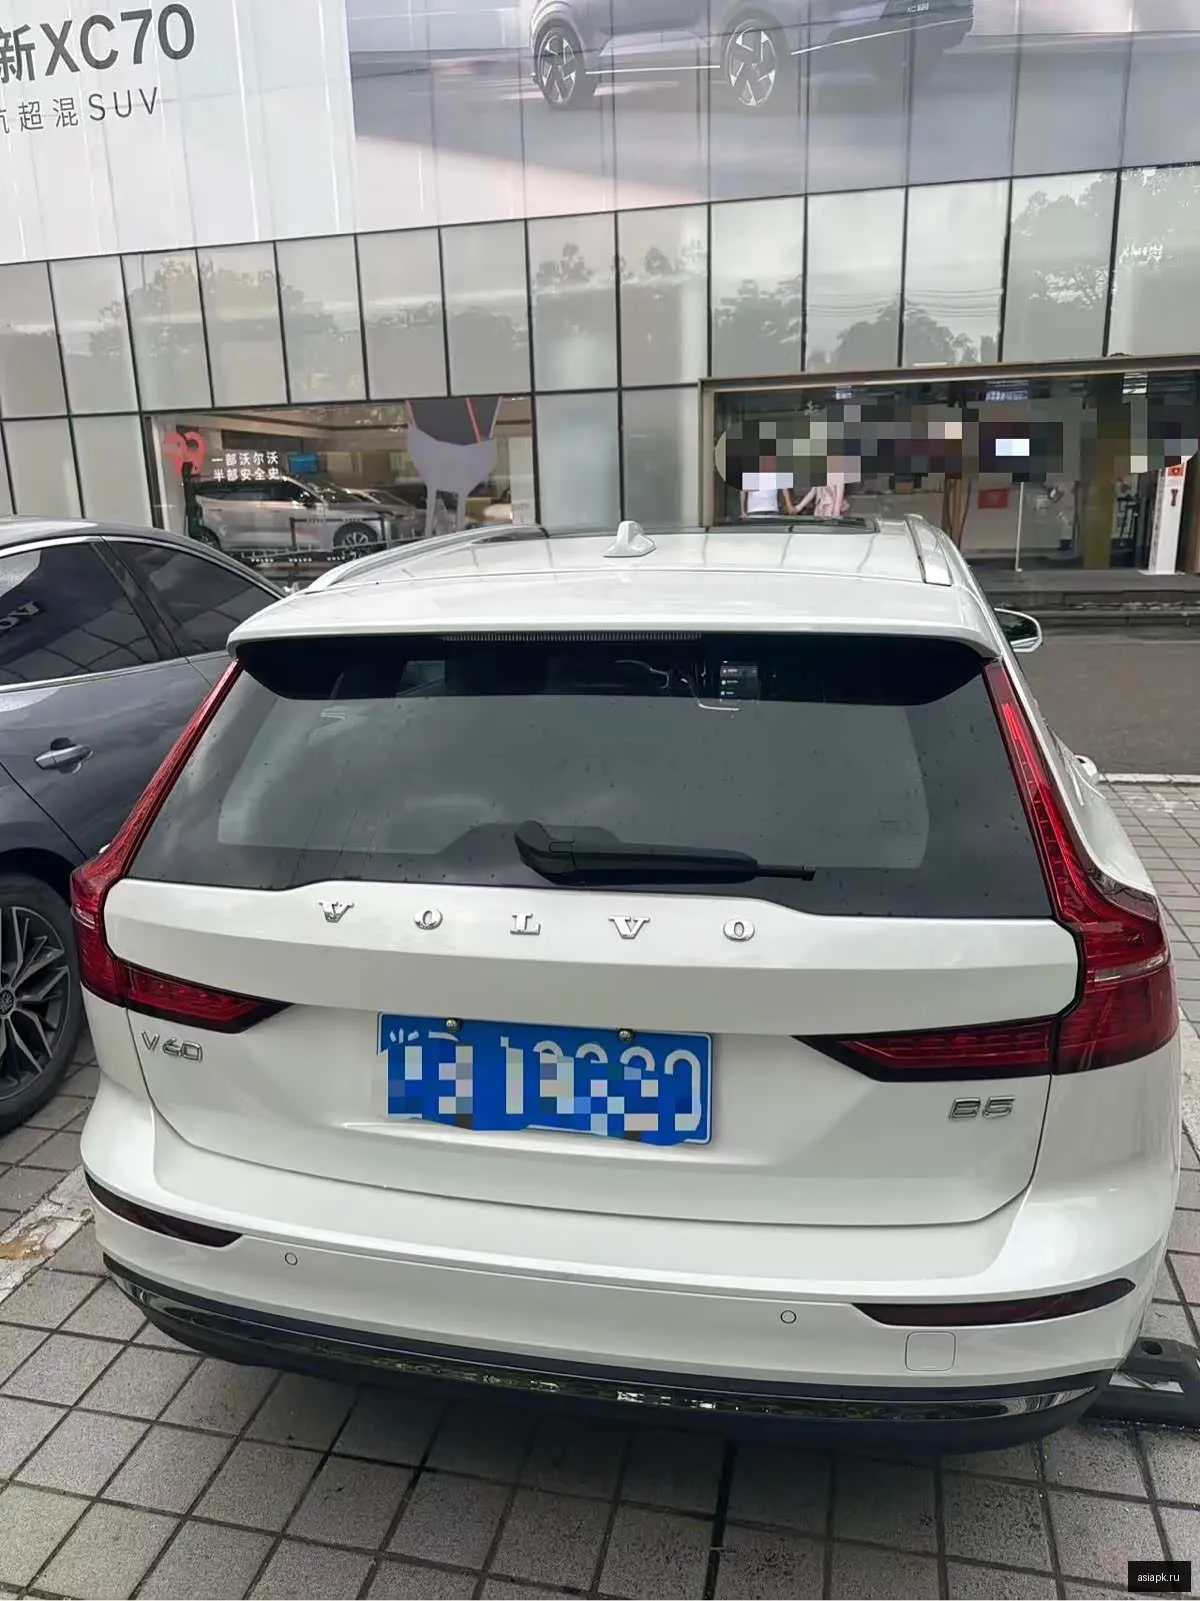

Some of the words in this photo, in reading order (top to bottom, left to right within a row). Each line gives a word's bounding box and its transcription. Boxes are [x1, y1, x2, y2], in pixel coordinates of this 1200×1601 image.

[211, 451, 279, 467] 一部沃尔沃
[213, 467, 281, 482] 半部安全史
[318, 900, 756, 942] VOLVO
[141, 1030, 203, 1063] V60
[947, 1095, 1016, 1120] B5
